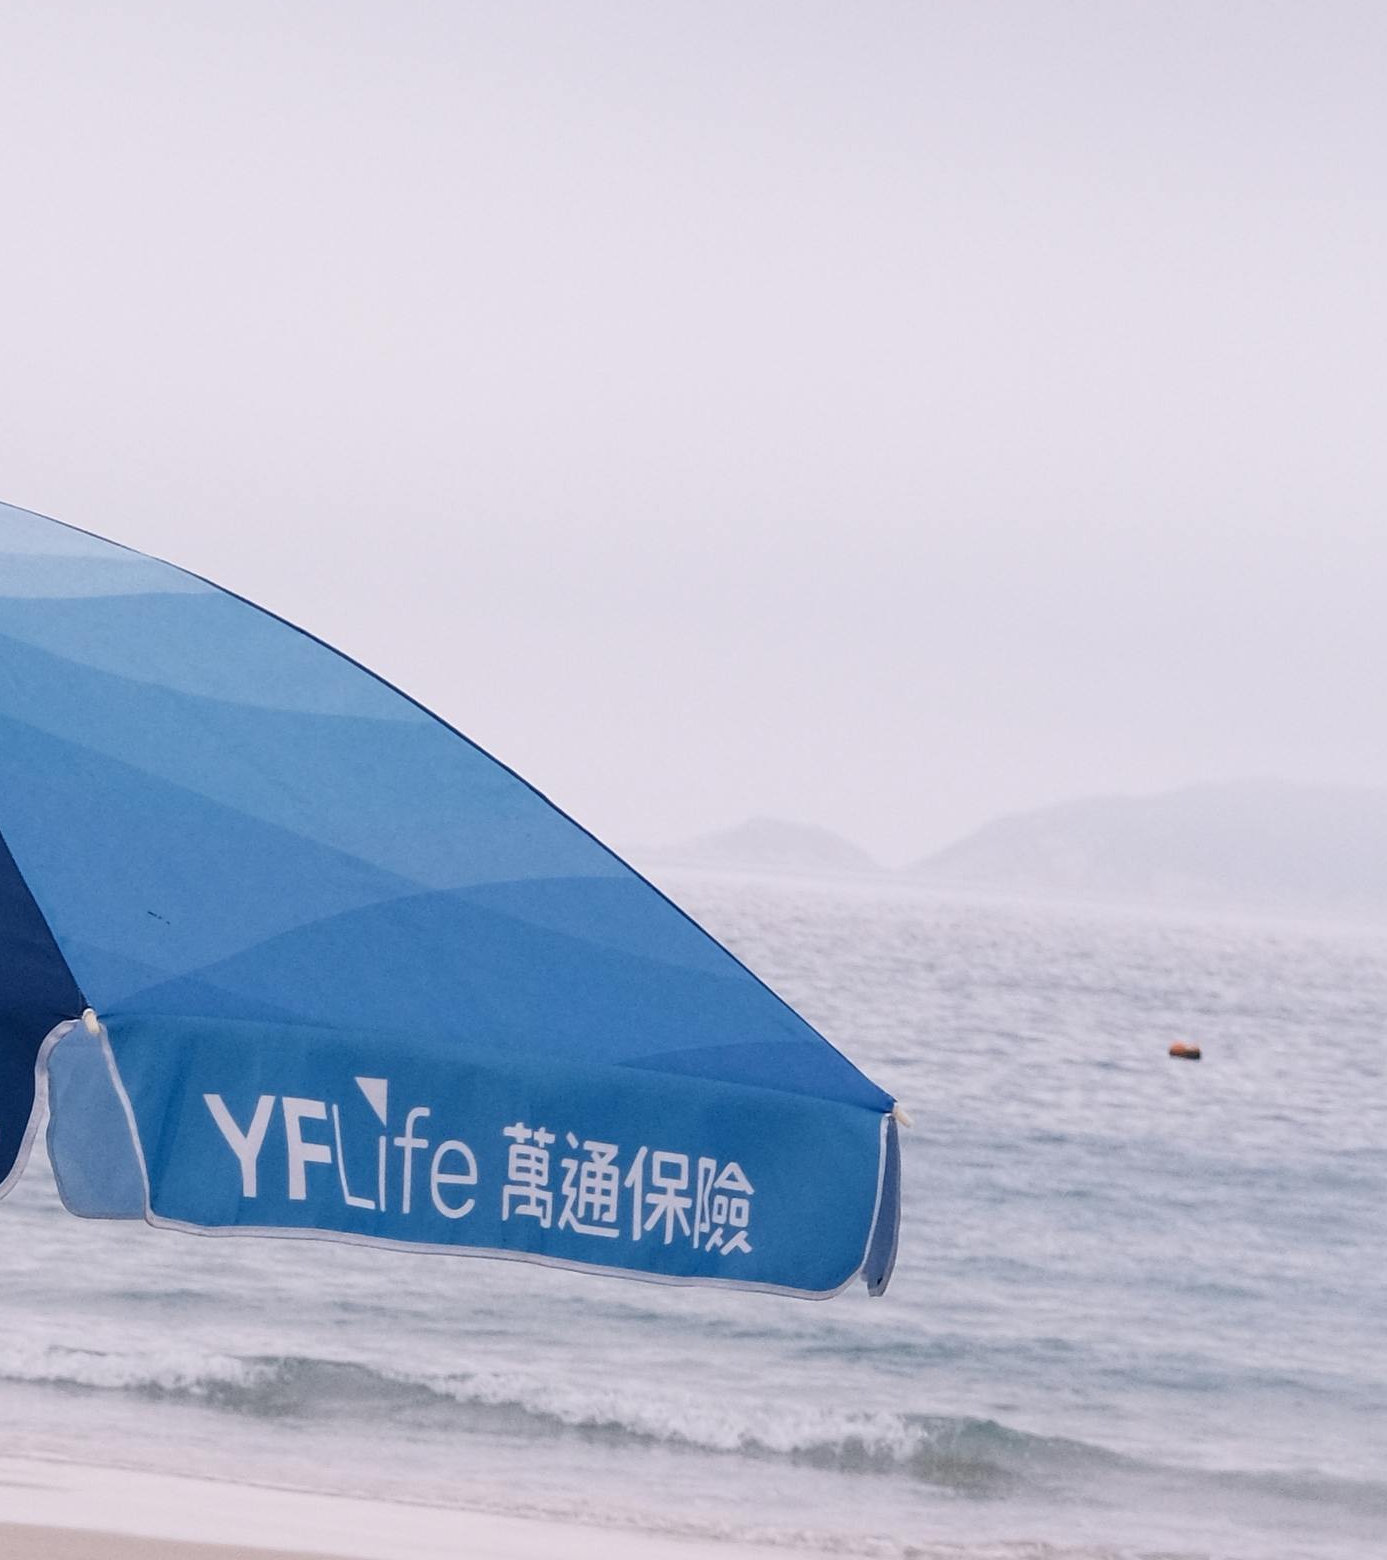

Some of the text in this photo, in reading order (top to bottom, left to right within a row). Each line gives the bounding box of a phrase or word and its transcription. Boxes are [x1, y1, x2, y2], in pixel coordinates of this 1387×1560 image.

[202, 1075, 756, 1256] YFLife 萬通保險
